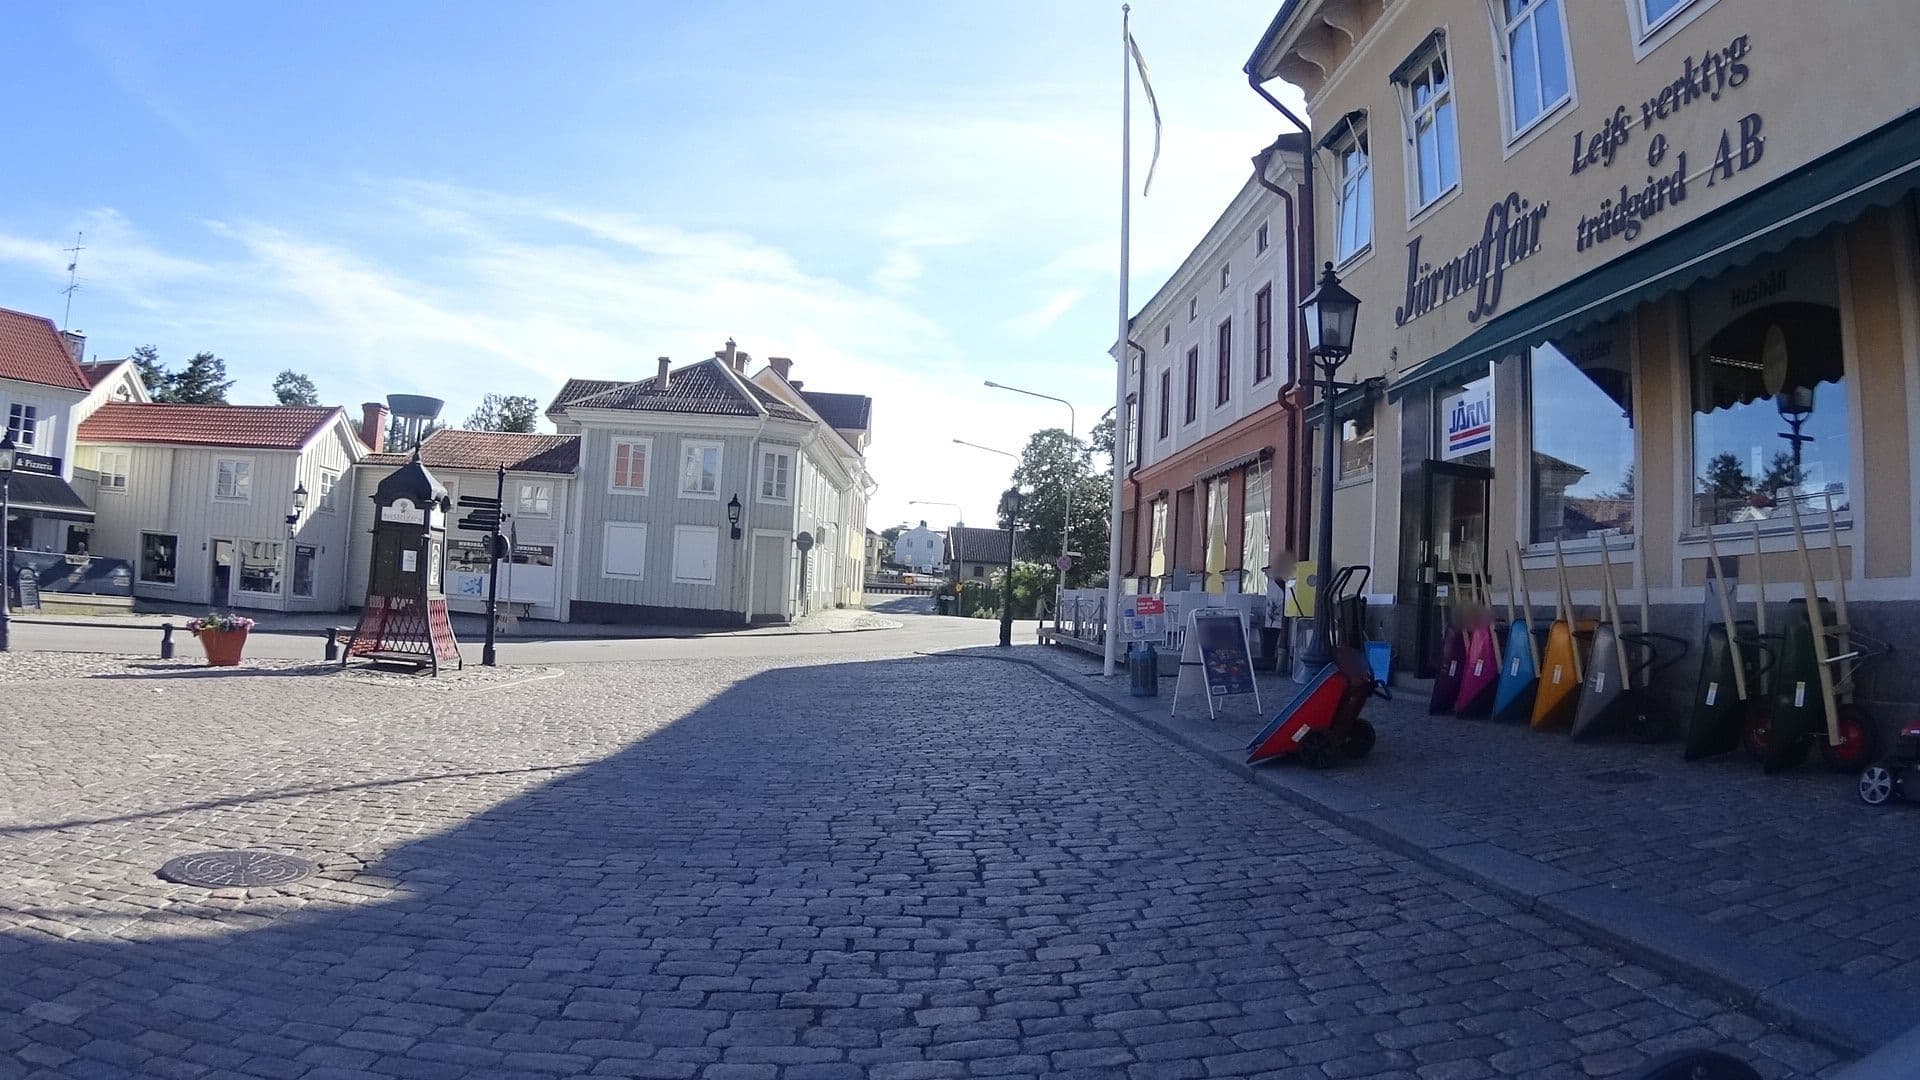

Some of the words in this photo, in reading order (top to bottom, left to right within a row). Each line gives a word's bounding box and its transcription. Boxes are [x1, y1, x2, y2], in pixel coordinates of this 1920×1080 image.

[1570, 105, 1631, 176] Leifs
[1640, 34, 1751, 130] verktyg
[1648, 134, 1668, 167] o
[1577, 153, 1688, 252] trädgård
[1707, 112, 1766, 187] AB
[1395, 191, 1549, 327] Järnaffär
[25, 459, 53, 471] Pizzeria
